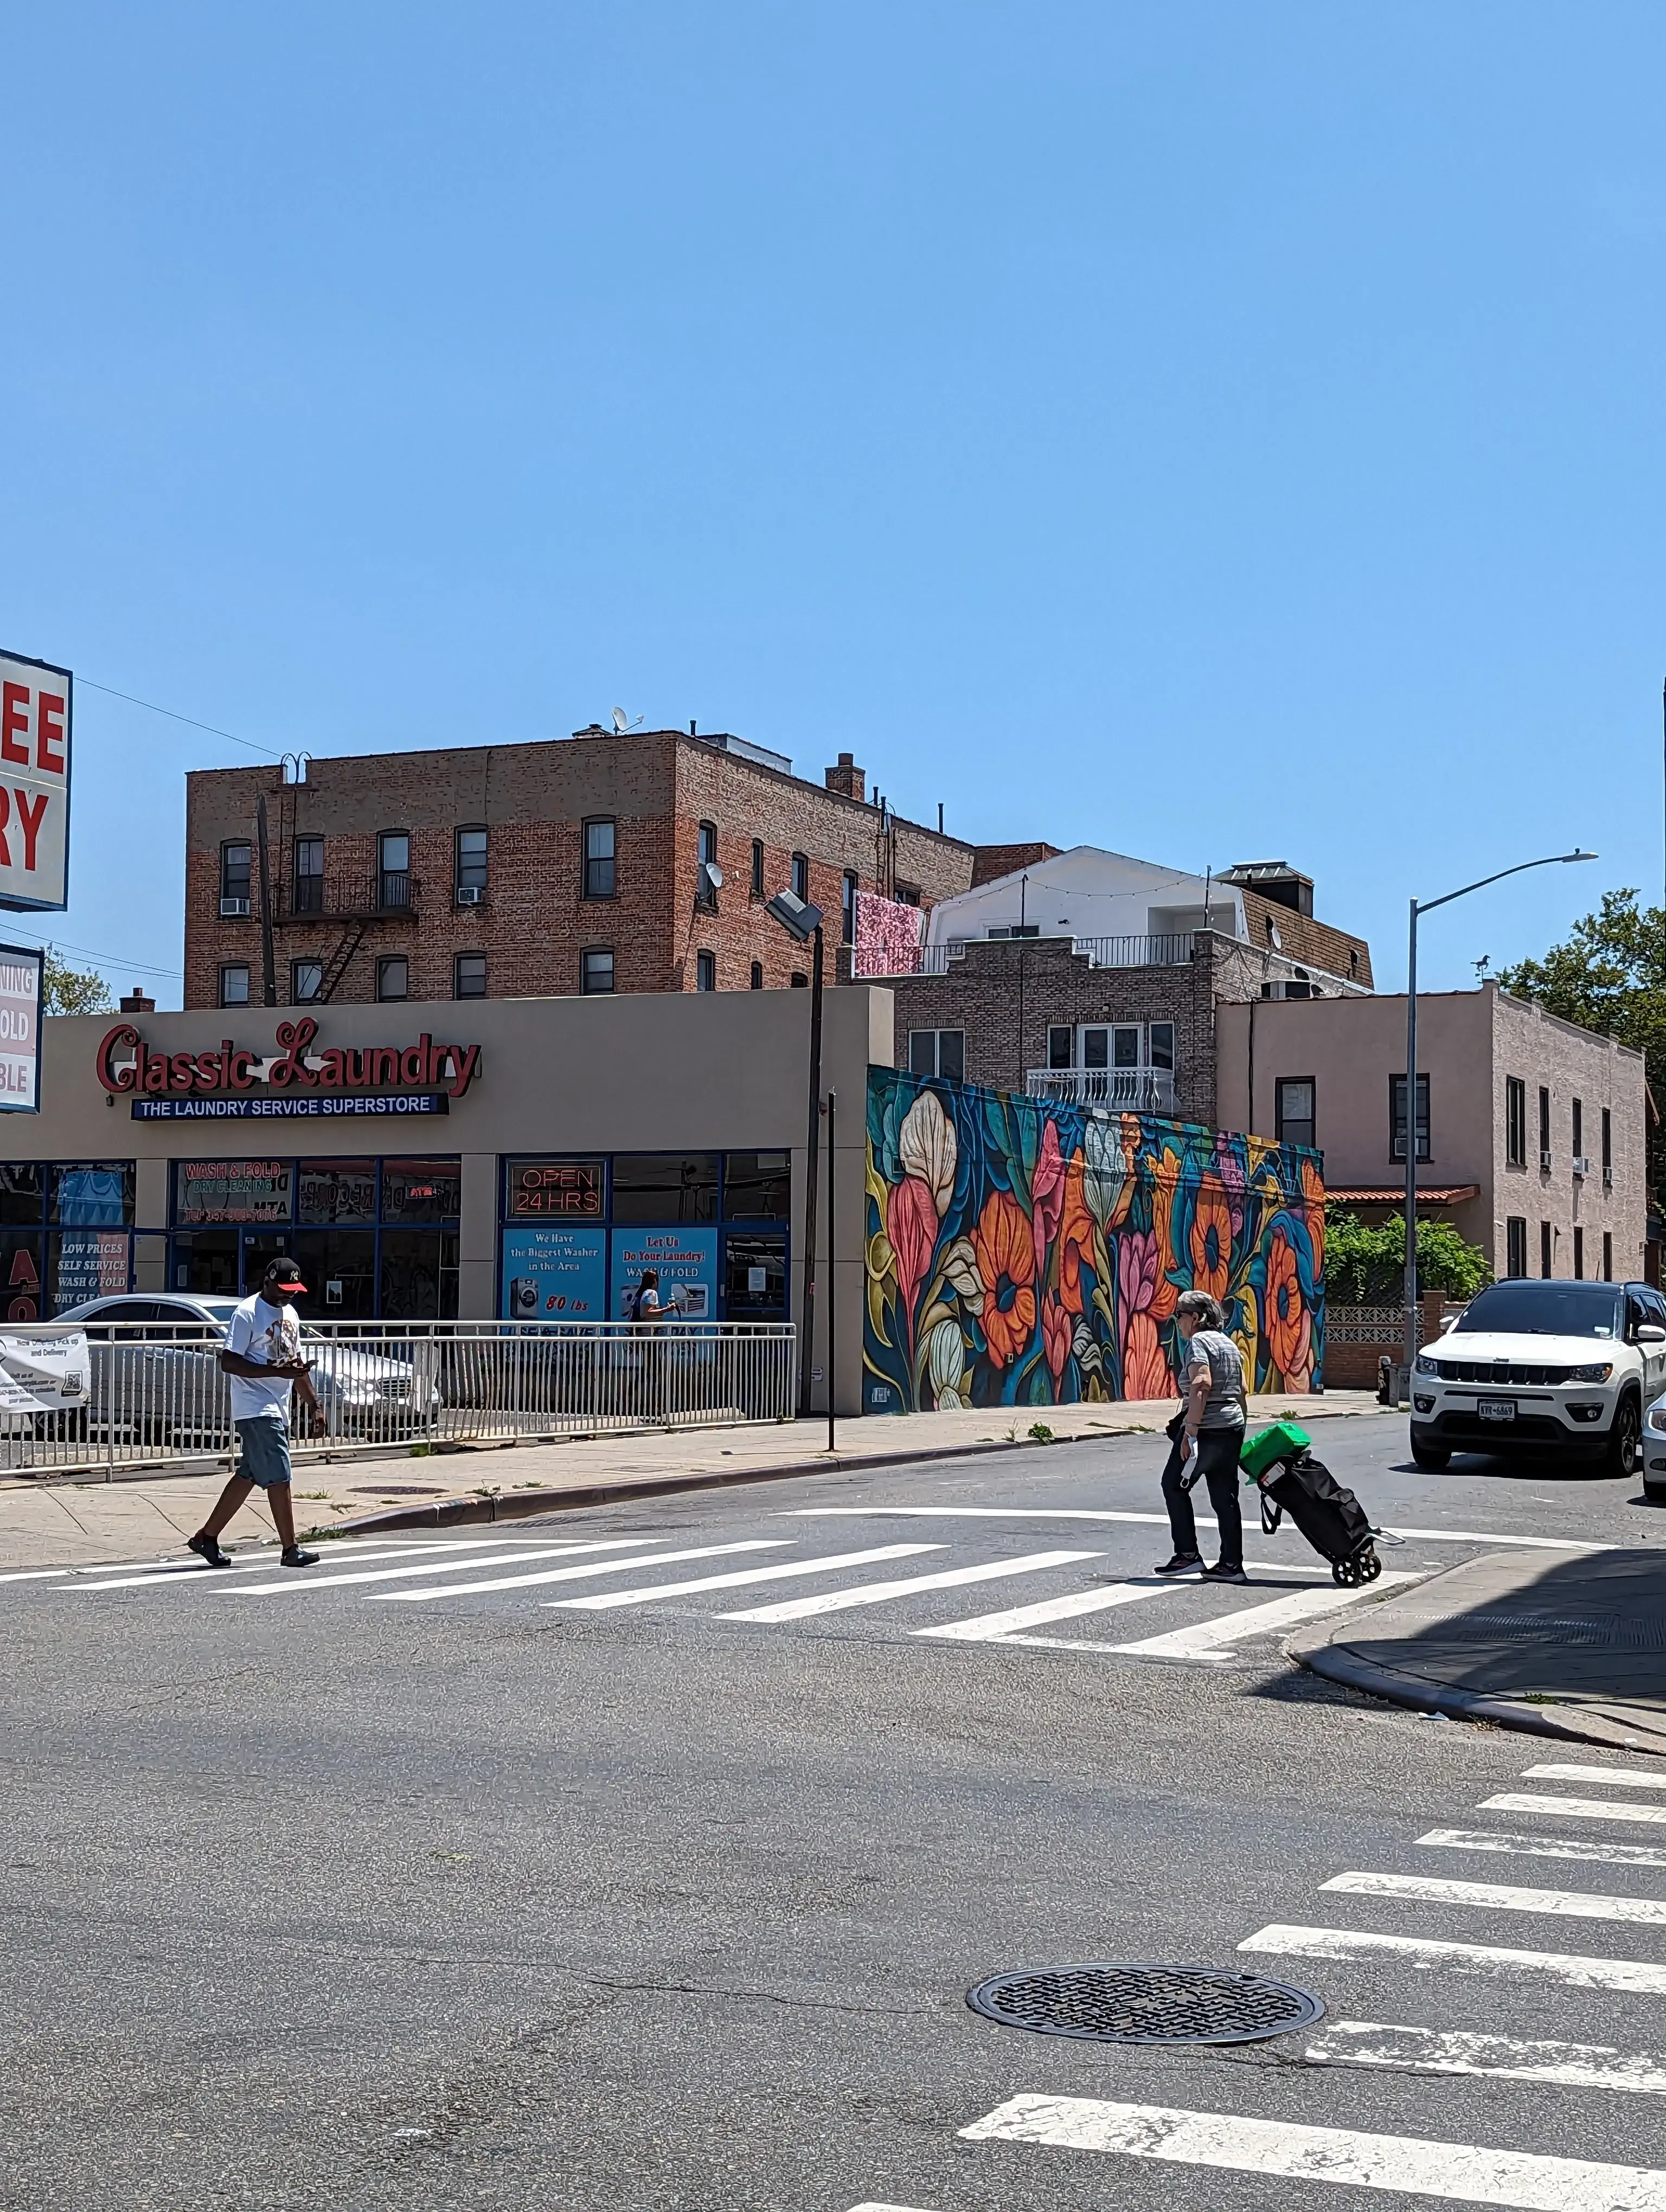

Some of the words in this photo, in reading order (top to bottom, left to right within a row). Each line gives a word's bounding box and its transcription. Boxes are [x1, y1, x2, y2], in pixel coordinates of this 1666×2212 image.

[1, 680, 65, 775] EE
[96, 1024, 258, 1094] Classic
[270, 1017, 482, 1098] Laundry
[141, 1102, 171, 1116] THE
[175, 1100, 248, 1116] LAUNDRY
[252, 1099, 318, 1115] SERVICE
[323, 1097, 430, 1114] SUPERSTORE
[185, 1162, 227, 1180] WASH
[229, 1163, 240, 1179] &
[244, 1162, 280, 1179] FOLD
[523, 1169, 593, 1188] OPEN
[193, 1180, 215, 1193] DRY
[516, 1192, 542, 1211] 24
[548, 1192, 598, 1211] HRS
[535, 1233, 549, 1243] We
[552, 1233, 574, 1243] Have
[646, 1236, 664, 1248] Let
[664, 1236, 680, 1248] Us
[61, 1243, 85, 1254] LOW
[86, 1243, 123, 1254] PRICES
[511, 1248, 526, 1258] the
[528, 1248, 561, 1259] Biggest
[564, 1248, 598, 1257] Washer
[622, 1250, 637, 1263] Do
[638, 1250, 662, 1263] Your
[662, 1249, 706, 1264] Laundry!
[57, 1260, 82, 1270] SELF
[83, 1260, 126, 1270] SERVICE
[528, 1262, 538, 1271] in
[540, 1261, 555, 1271] the
[557, 1262, 580, 1271] Area
[671, 1267, 699, 1277] FOLD
[57, 1277, 87, 1287] WASH
[88, 1277, 98, 1287] &
[99, 1277, 126, 1287] FOLD
[53, 1293, 75, 1304] DRY
[546, 1294, 567, 1312] 80
[570, 1299, 588, 1311] lbs
